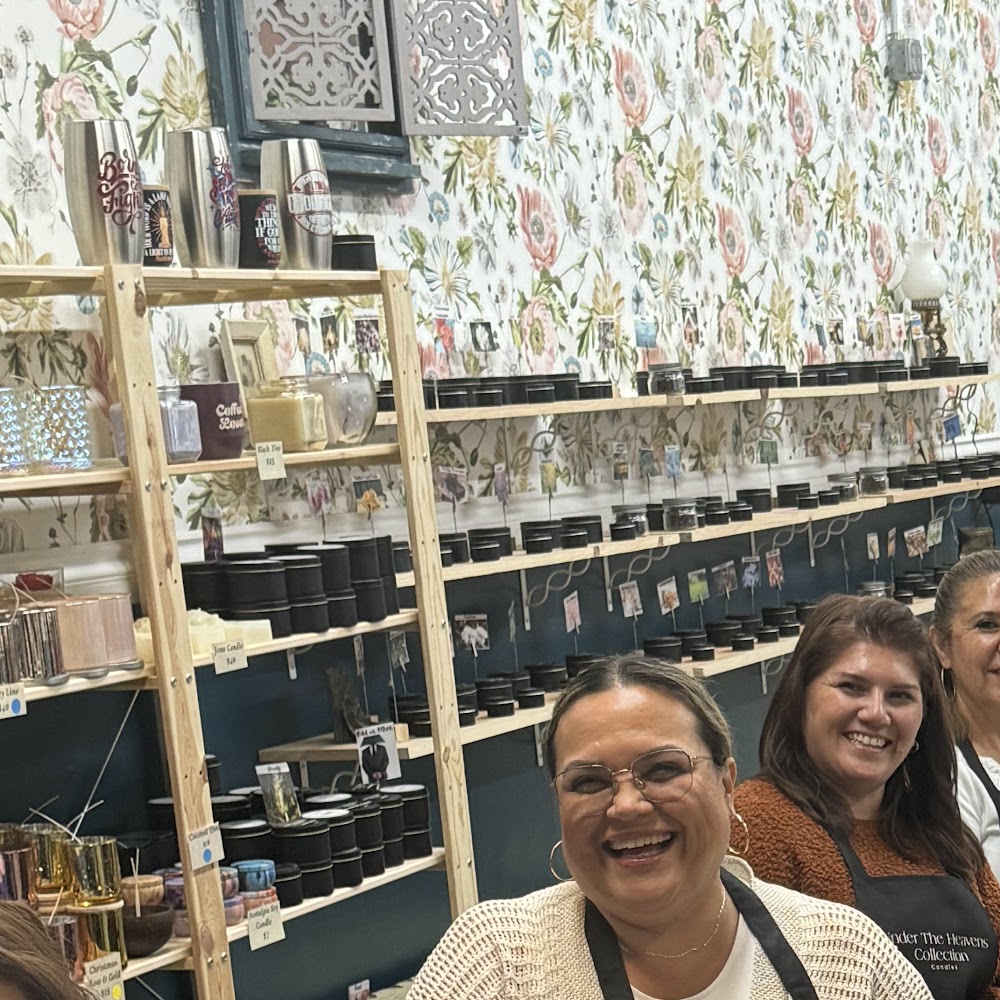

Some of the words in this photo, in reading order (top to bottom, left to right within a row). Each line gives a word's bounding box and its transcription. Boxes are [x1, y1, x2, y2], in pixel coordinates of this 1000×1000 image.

[887, 930, 919, 945] nder
[920, 930, 944, 946] The
[946, 932, 989, 949] Heavens
[914, 947, 970, 962] Collection
